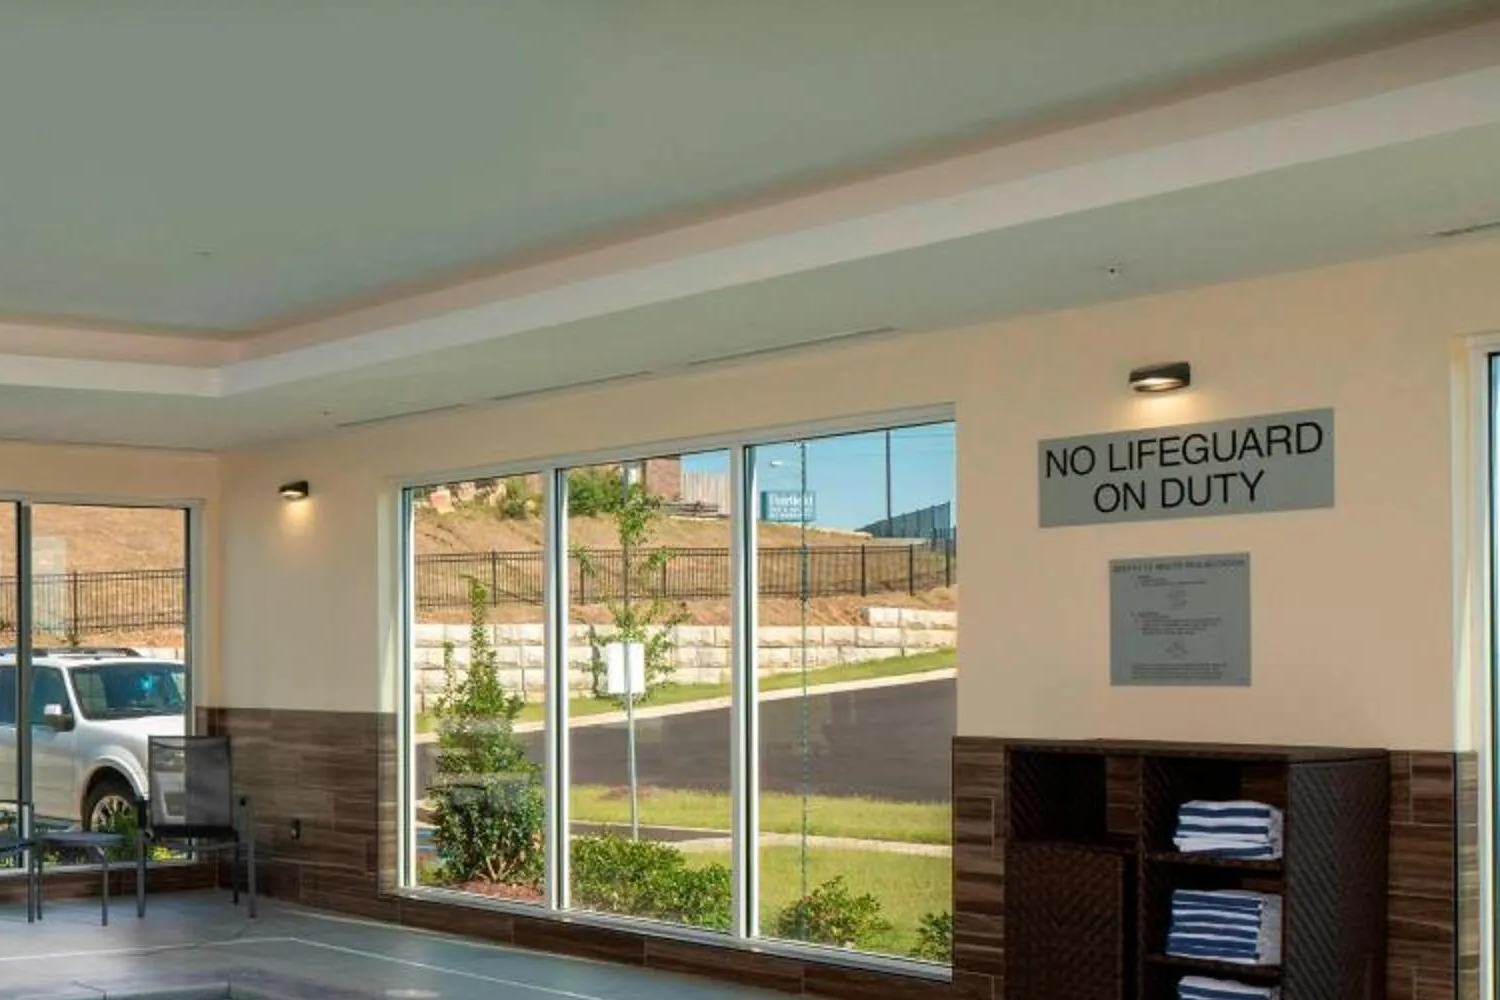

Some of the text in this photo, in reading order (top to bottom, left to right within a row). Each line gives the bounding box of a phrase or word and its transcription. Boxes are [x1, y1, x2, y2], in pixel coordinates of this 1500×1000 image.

[1045, 421, 1323, 478] NO LIFEGUARD
[1093, 469, 1265, 513] ON DUTY
